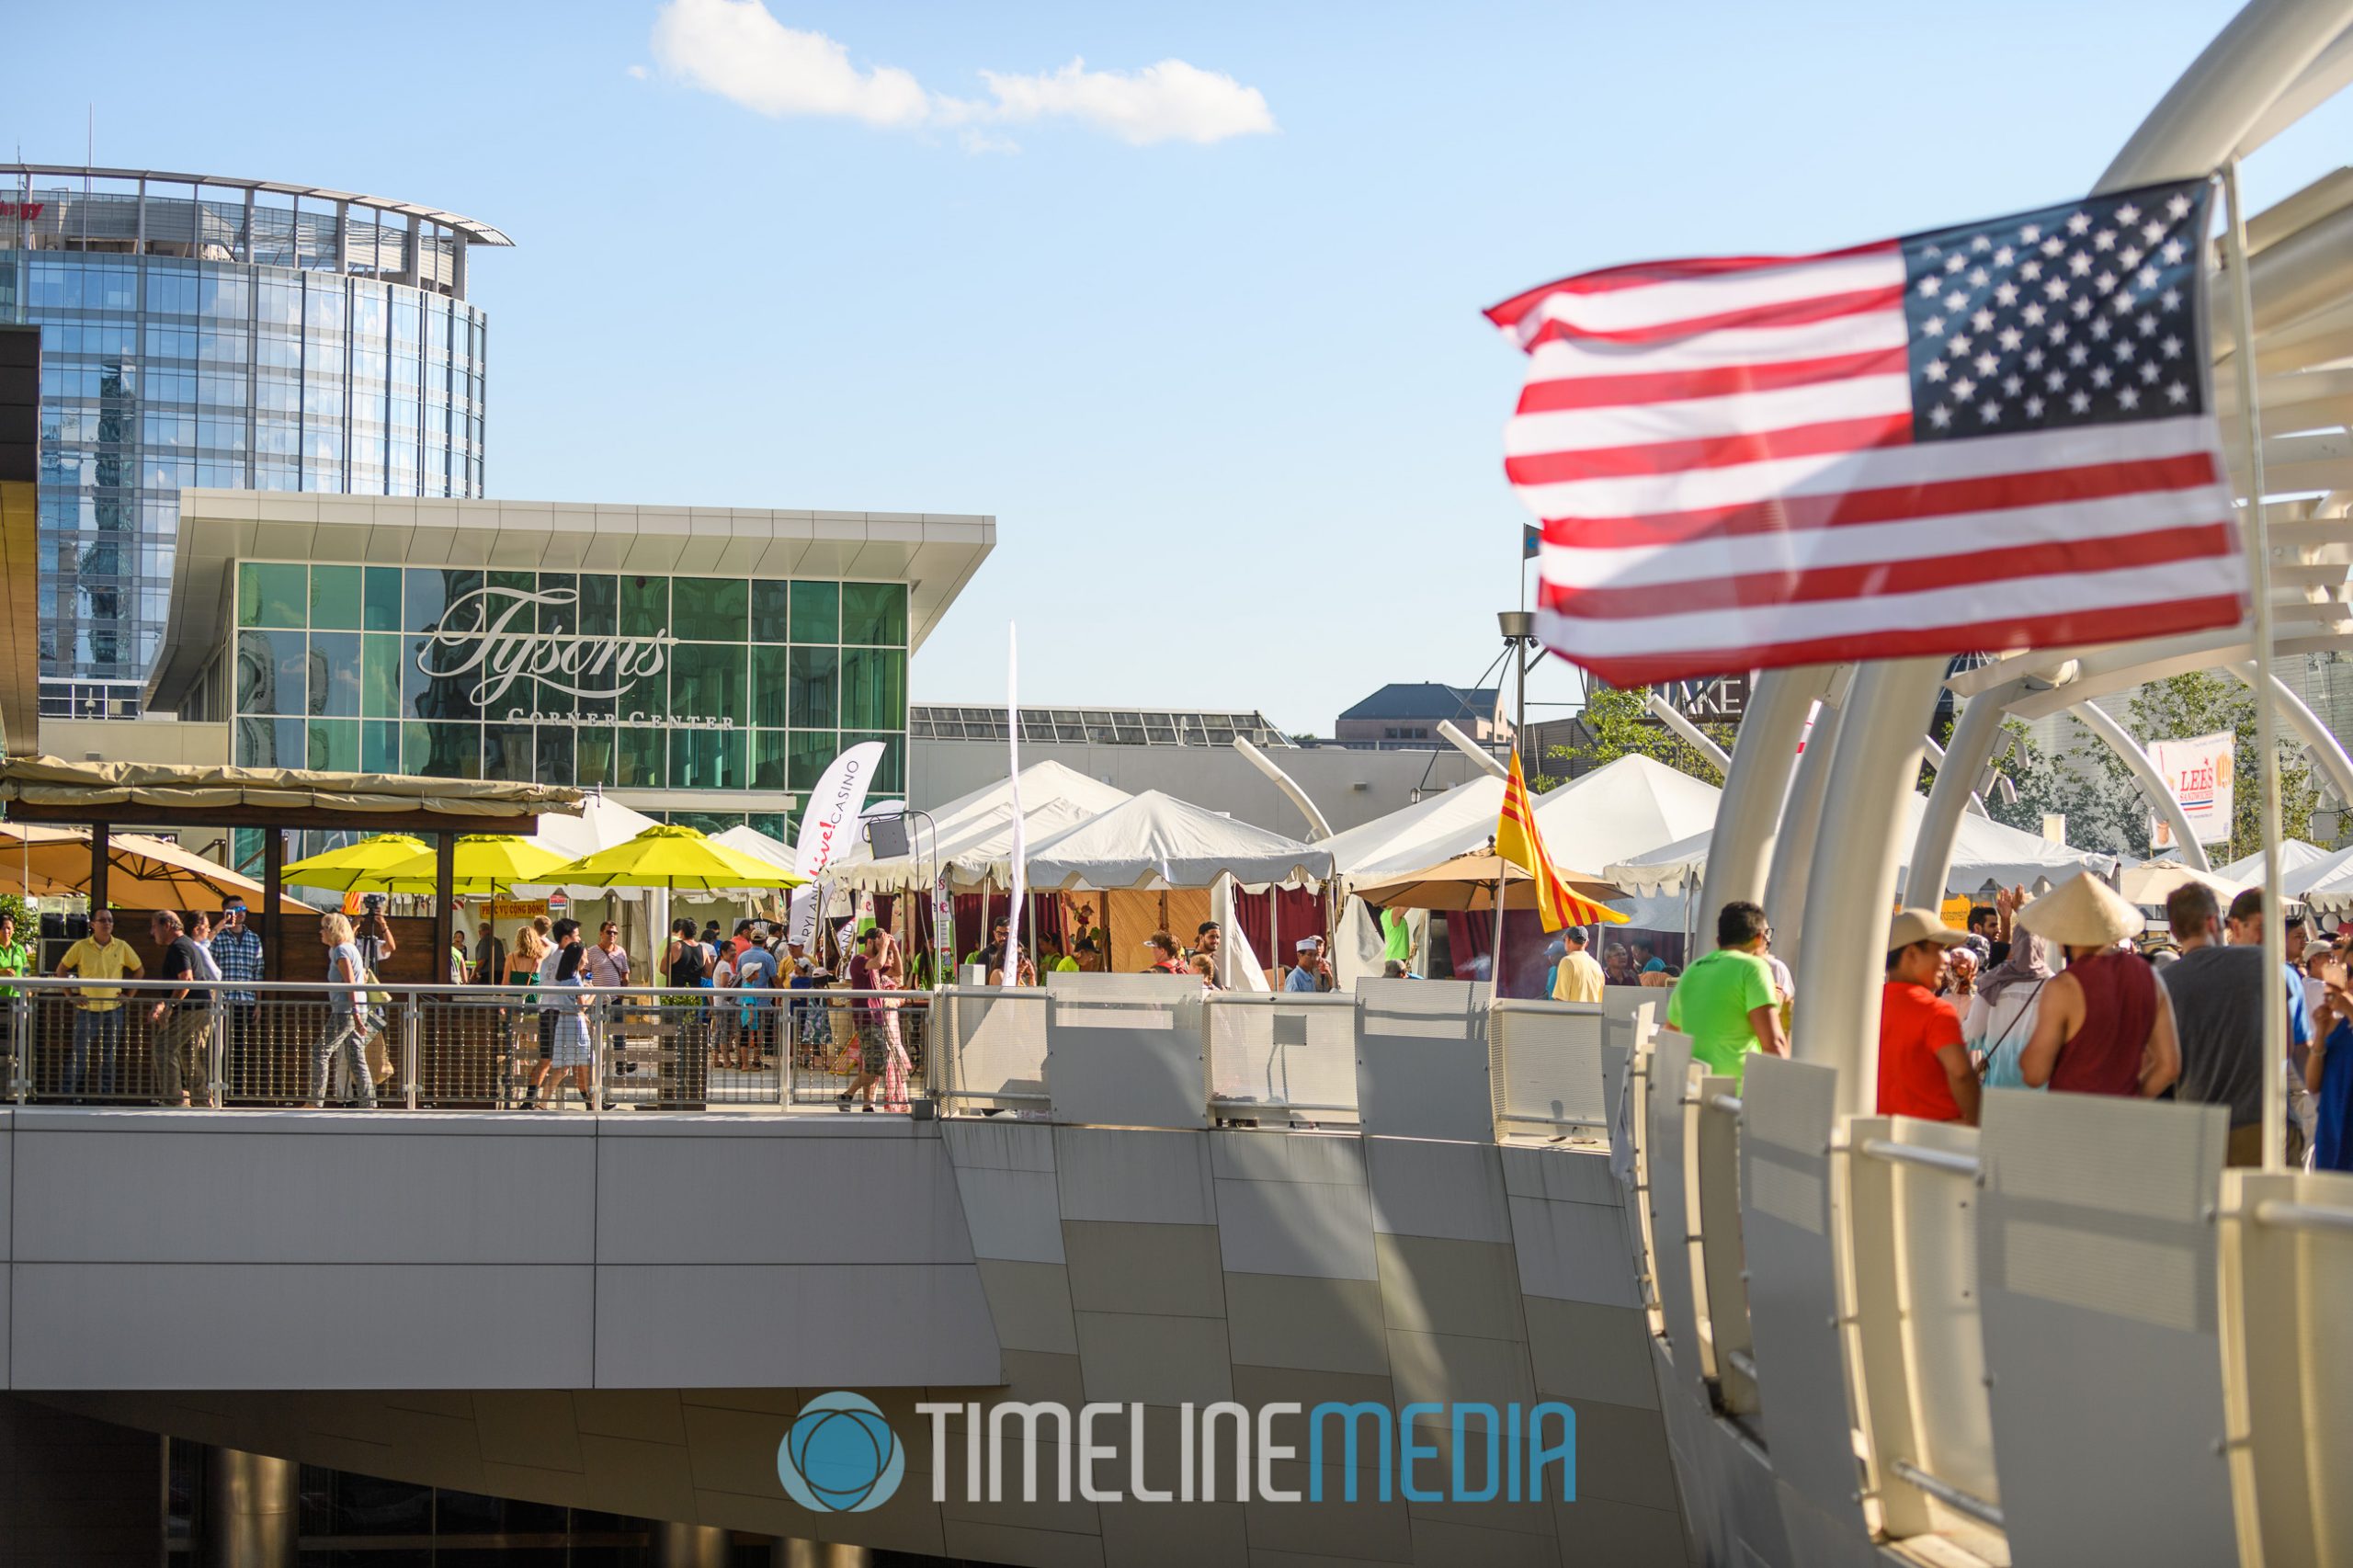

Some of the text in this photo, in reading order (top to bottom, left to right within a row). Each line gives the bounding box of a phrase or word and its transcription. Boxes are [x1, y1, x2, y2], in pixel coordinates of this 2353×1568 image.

[416, 585, 665, 706] Tysons
[506, 707, 735, 731] CORNER CENTER
[830, 760, 859, 824] CASINO
[482, 905, 498, 915] PHC
